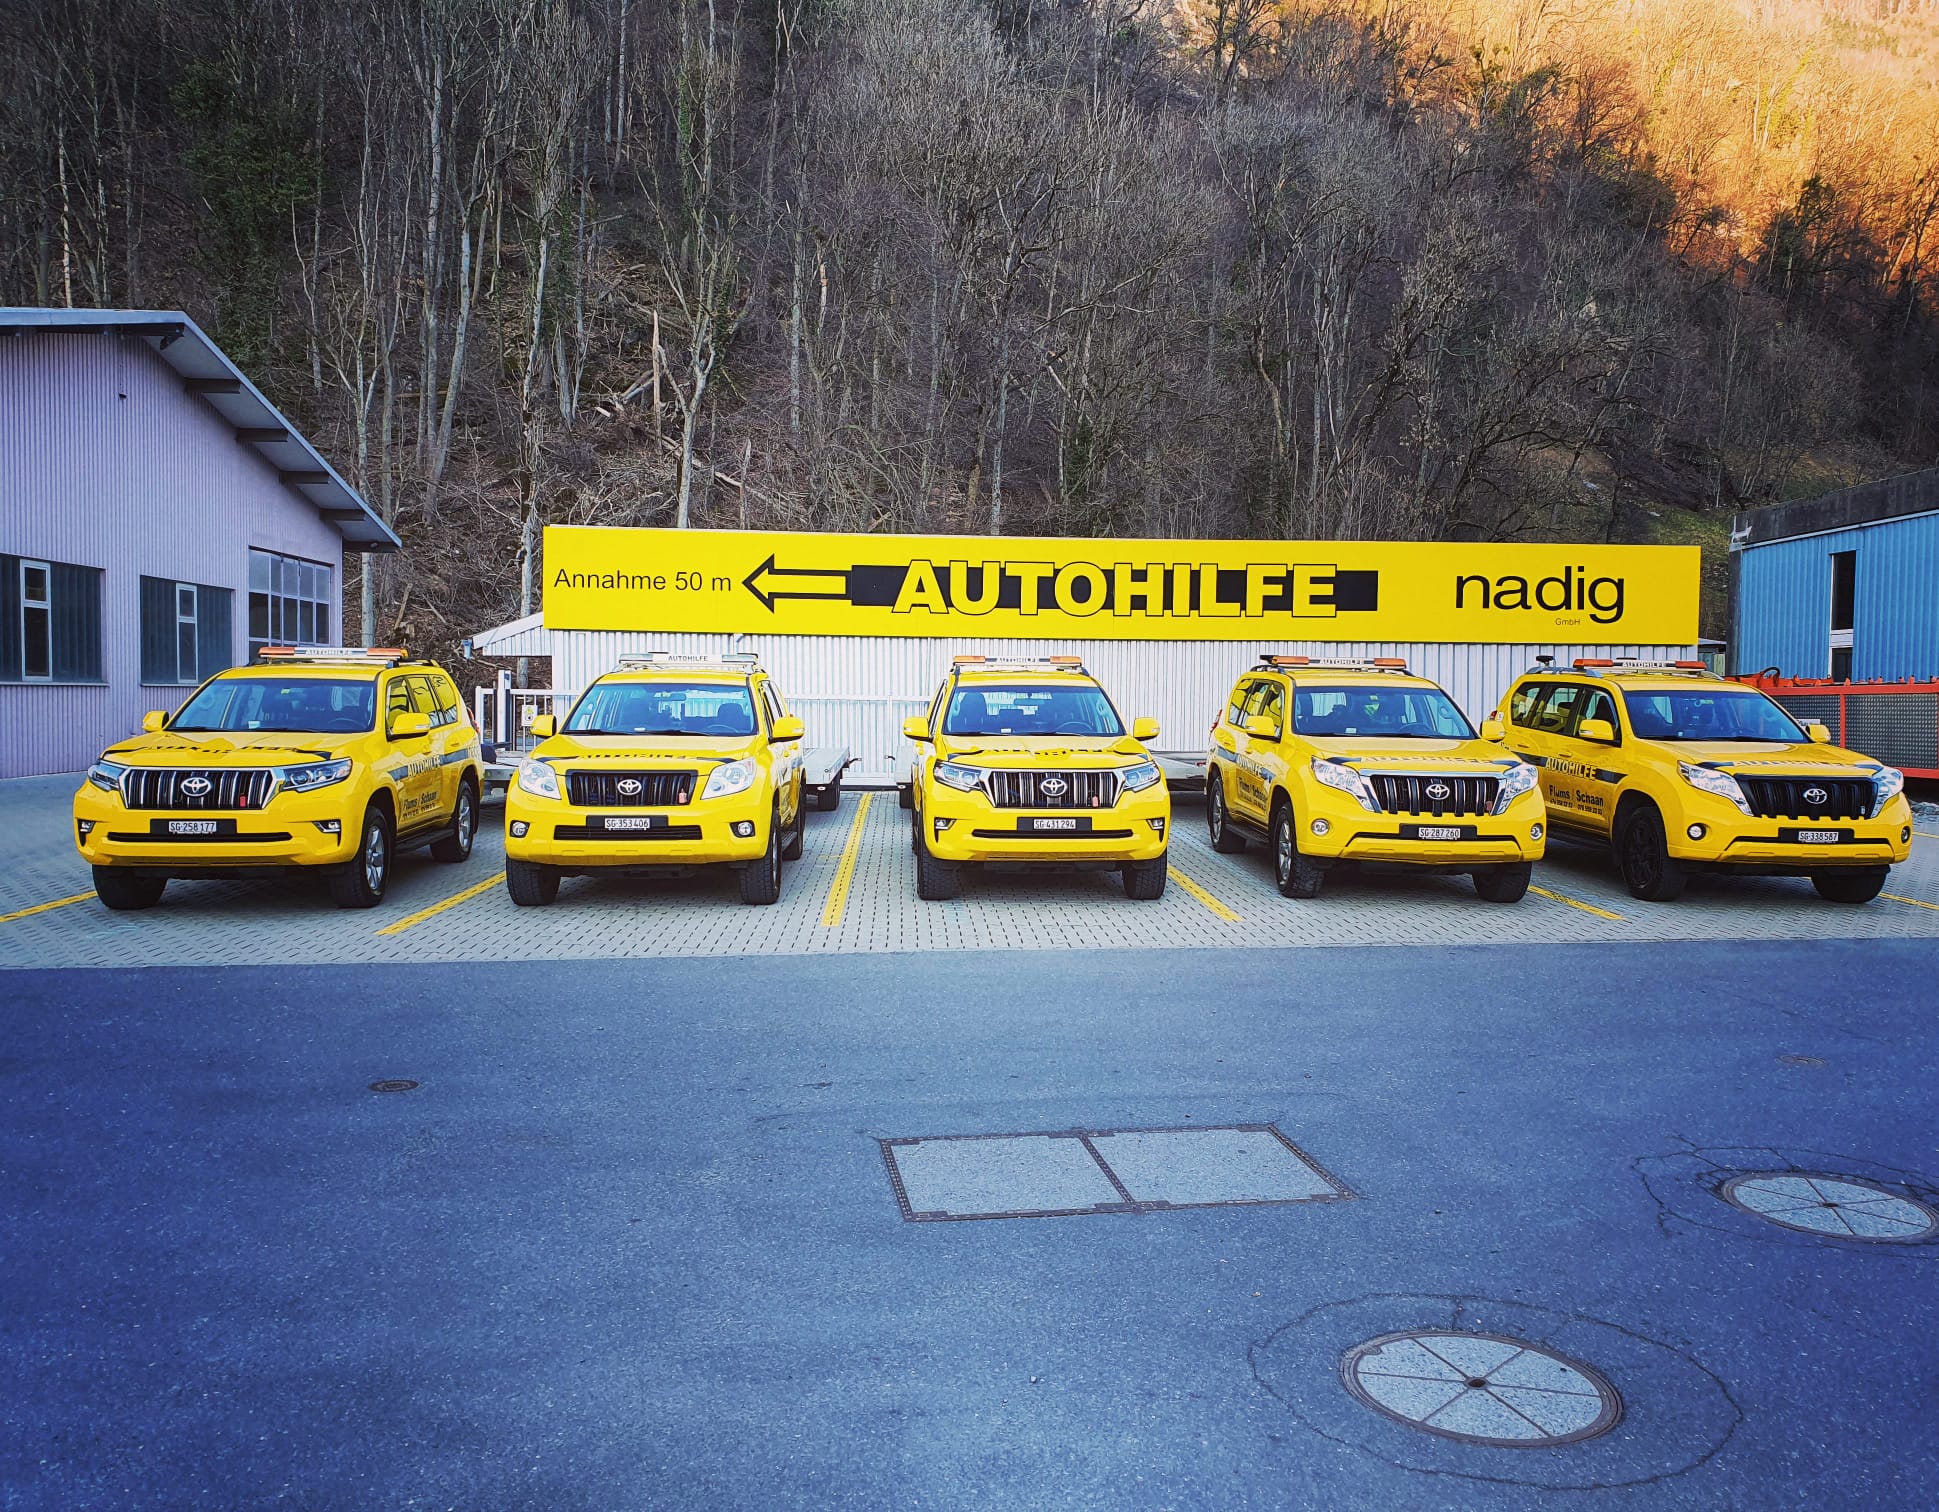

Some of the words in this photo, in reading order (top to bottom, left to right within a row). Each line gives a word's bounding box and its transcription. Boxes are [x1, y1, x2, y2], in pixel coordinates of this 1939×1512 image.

[553, 568, 667, 591] Annahme
[675, 571, 703, 591] 50
[711, 576, 732, 592] m
[891, 558, 1337, 618] AUTOHILFE
[1455, 565, 1625, 624] nadig
[1554, 617, 1581, 626] GmbH
[1545, 756, 1598, 781] AUTOHILFE
[1549, 784, 1570, 800] Flums
[1575, 789, 1604, 807] Schaan
